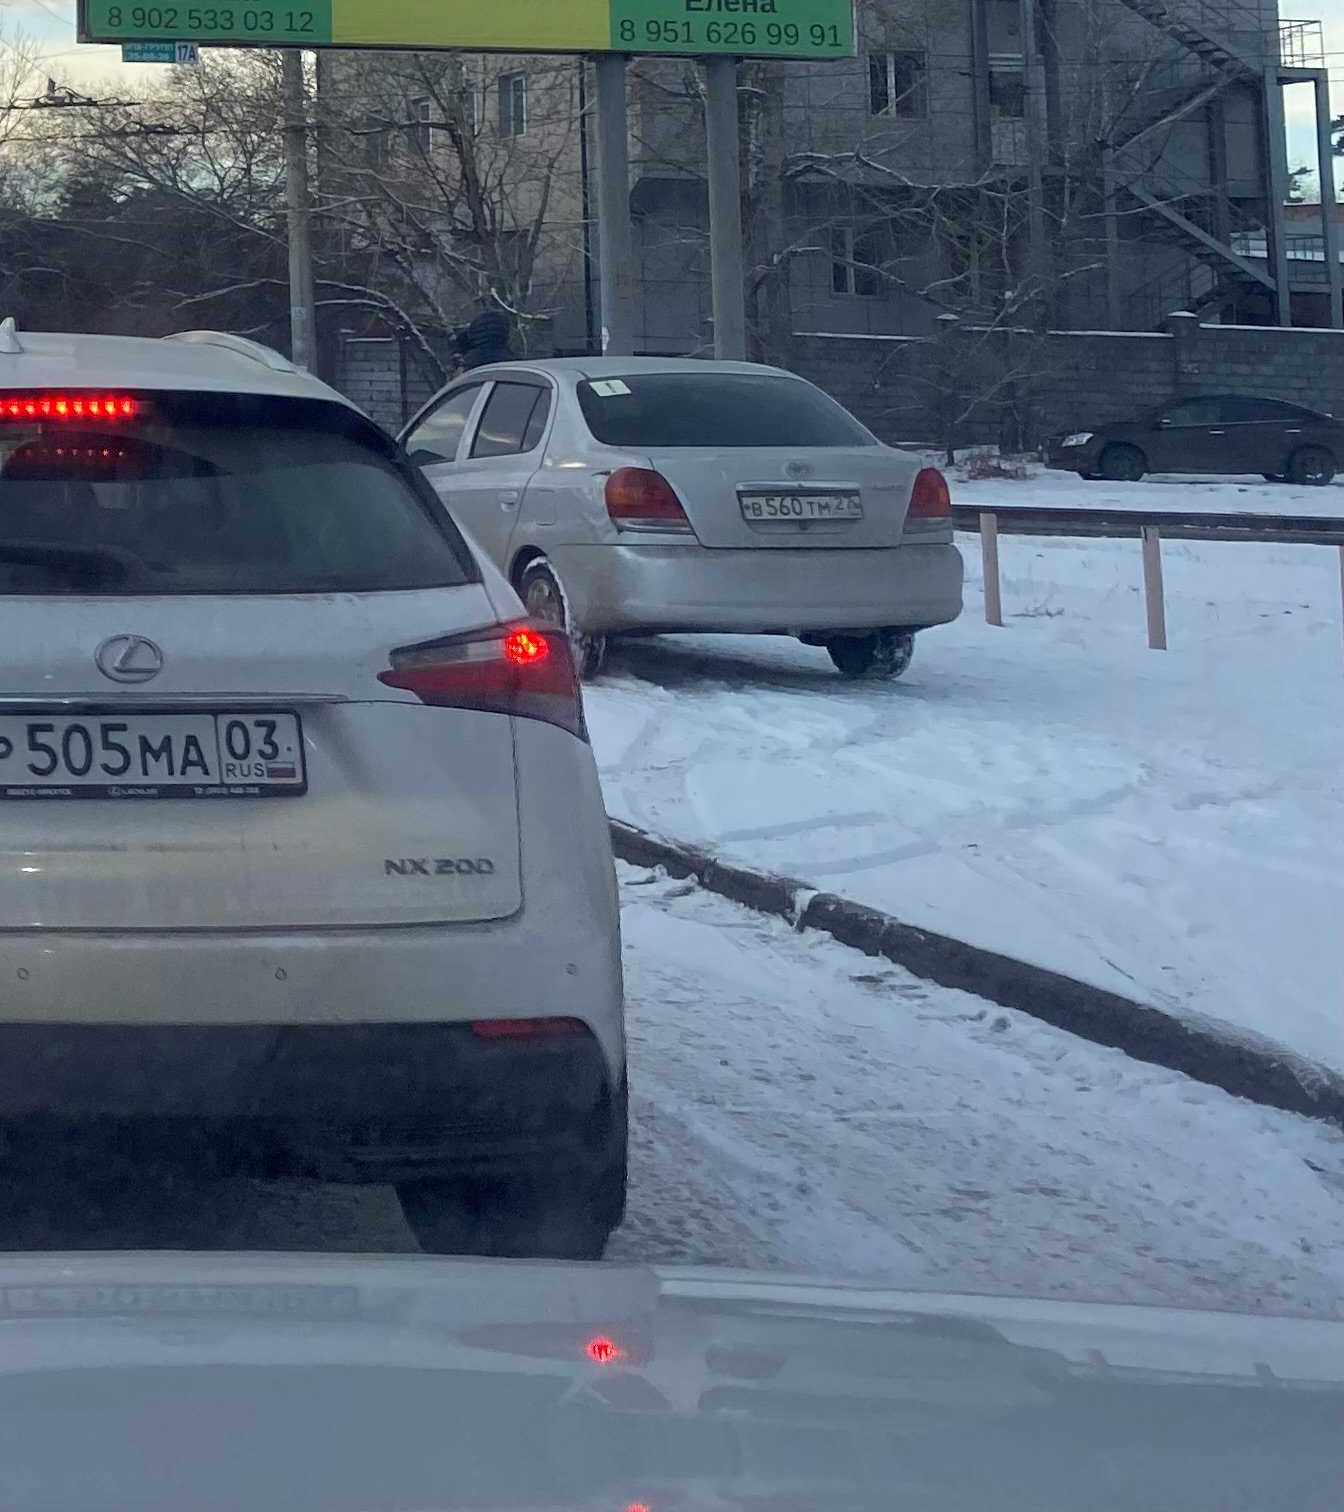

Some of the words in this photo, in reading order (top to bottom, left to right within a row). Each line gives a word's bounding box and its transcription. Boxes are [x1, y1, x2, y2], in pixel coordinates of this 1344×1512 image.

[108, 6, 122, 28] 8
[132, 7, 178, 29] 902
[188, 9, 234, 31] 533
[243, 10, 274, 31] 03
[285, 11, 314, 33] 12
[620, 19, 635, 42] 8
[646, 20, 694, 43] 951
[706, 21, 756, 45] 626
[766, 23, 799, 46] 99
[809, 24, 843, 47] 91
[225, 719, 279, 761] 03
[226, 763, 265, 778] RUS
[384, 858, 431, 876] NX
[433, 858, 494, 875] 200
